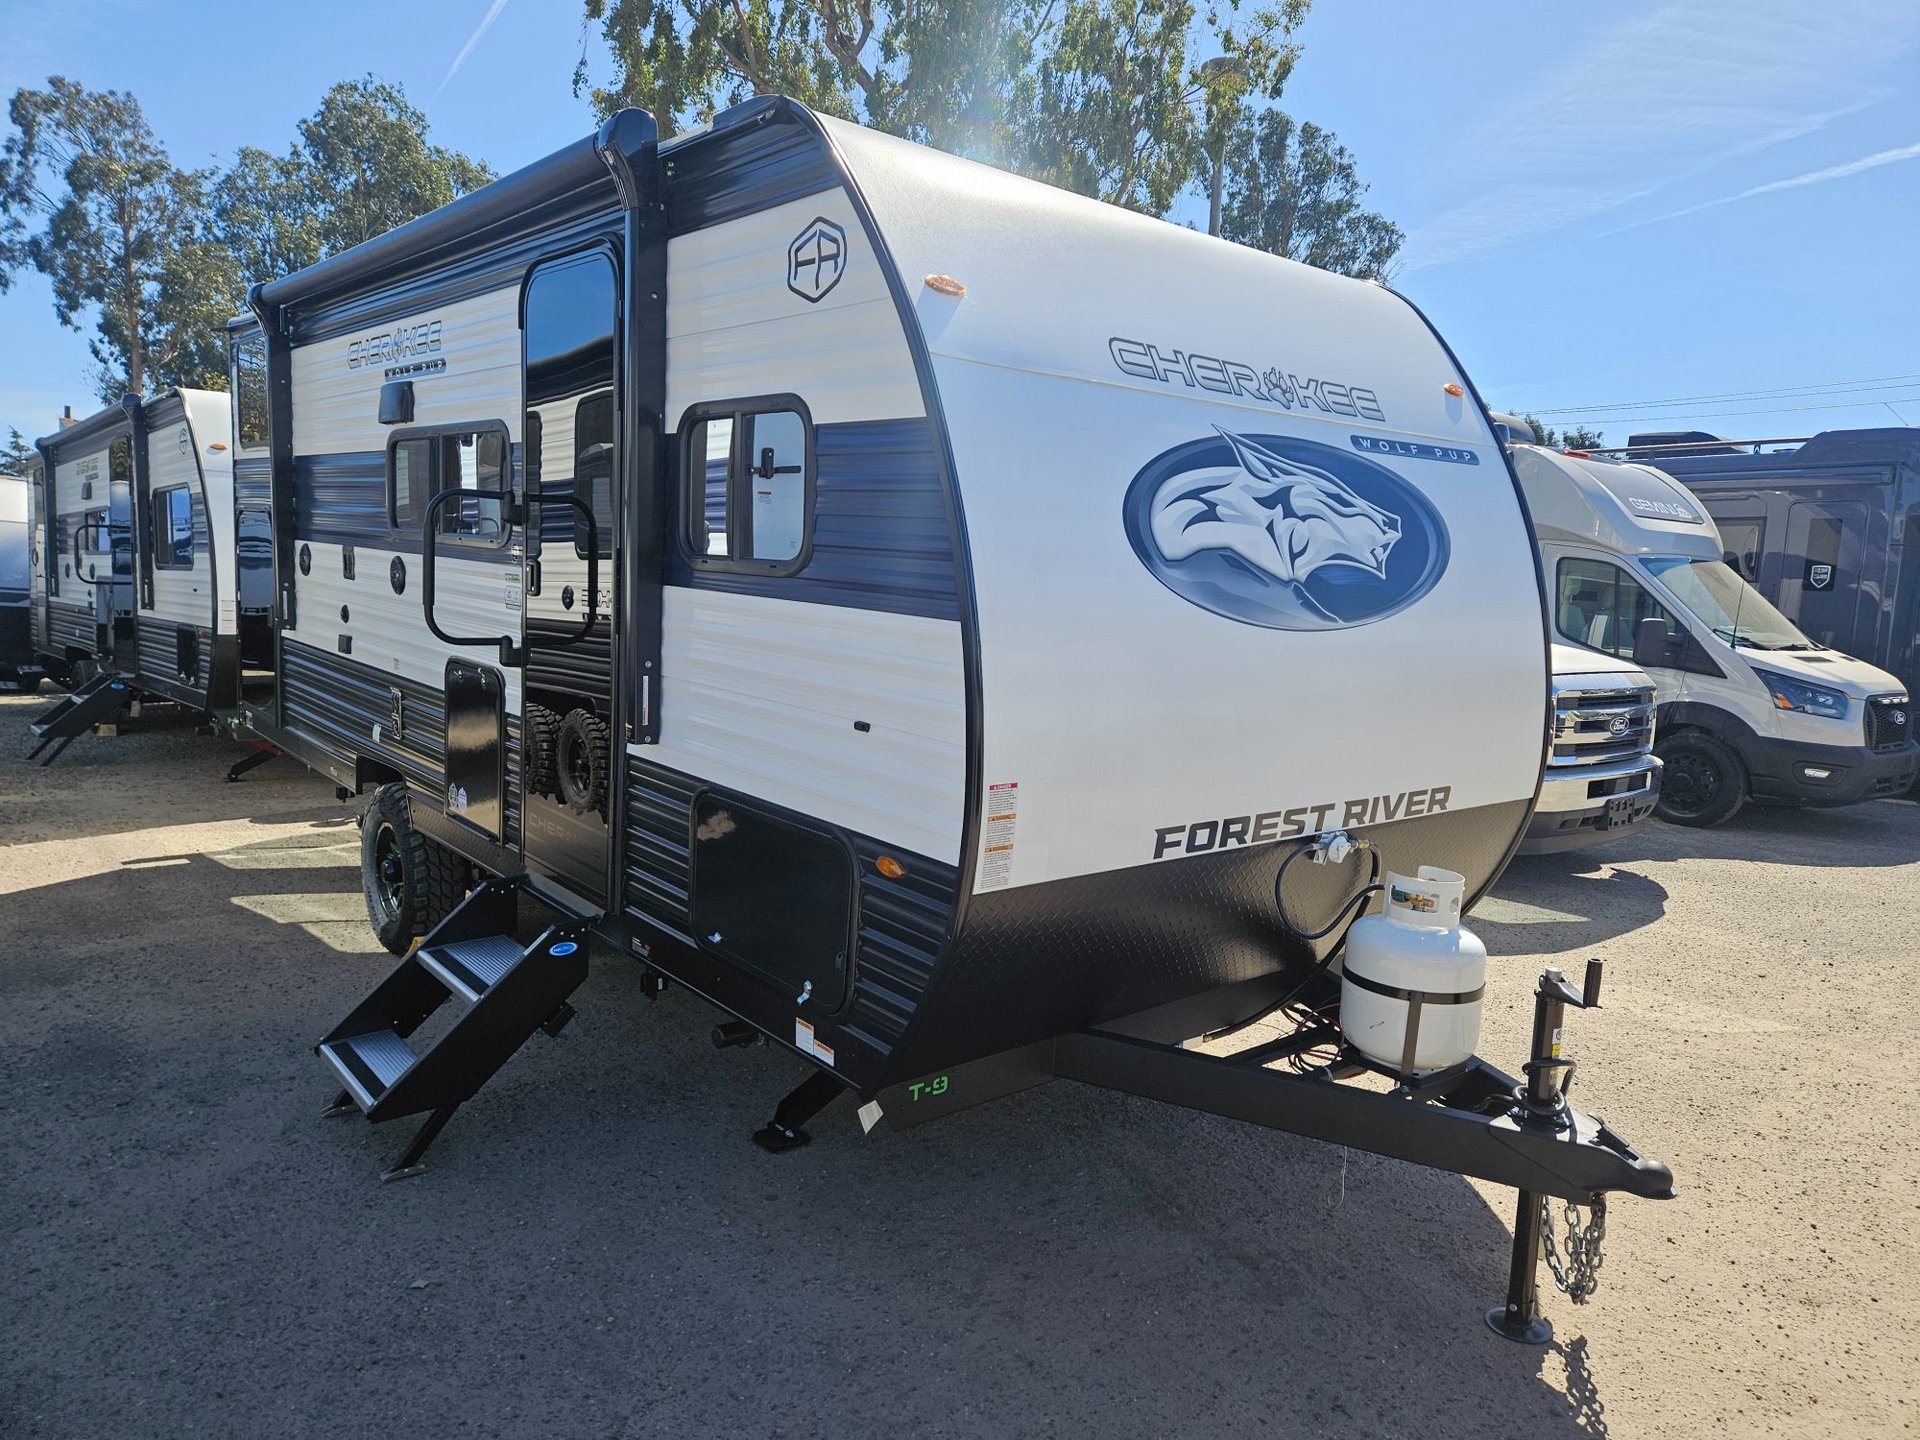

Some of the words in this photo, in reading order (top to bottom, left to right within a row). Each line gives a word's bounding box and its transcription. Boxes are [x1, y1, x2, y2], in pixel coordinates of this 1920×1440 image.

[347, 319, 443, 370] CHEROKEE
[387, 365, 415, 378] WOLF
[421, 360, 443, 372] PUP
[1108, 336, 1386, 422] CHEROKEE
[1359, 438, 1418, 455] WOLF
[1434, 448, 1471, 462] PUP
[1153, 803, 1336, 860] FOREST
[1341, 785, 1452, 828] RIVER
[908, 1075, 949, 1102] T-9
